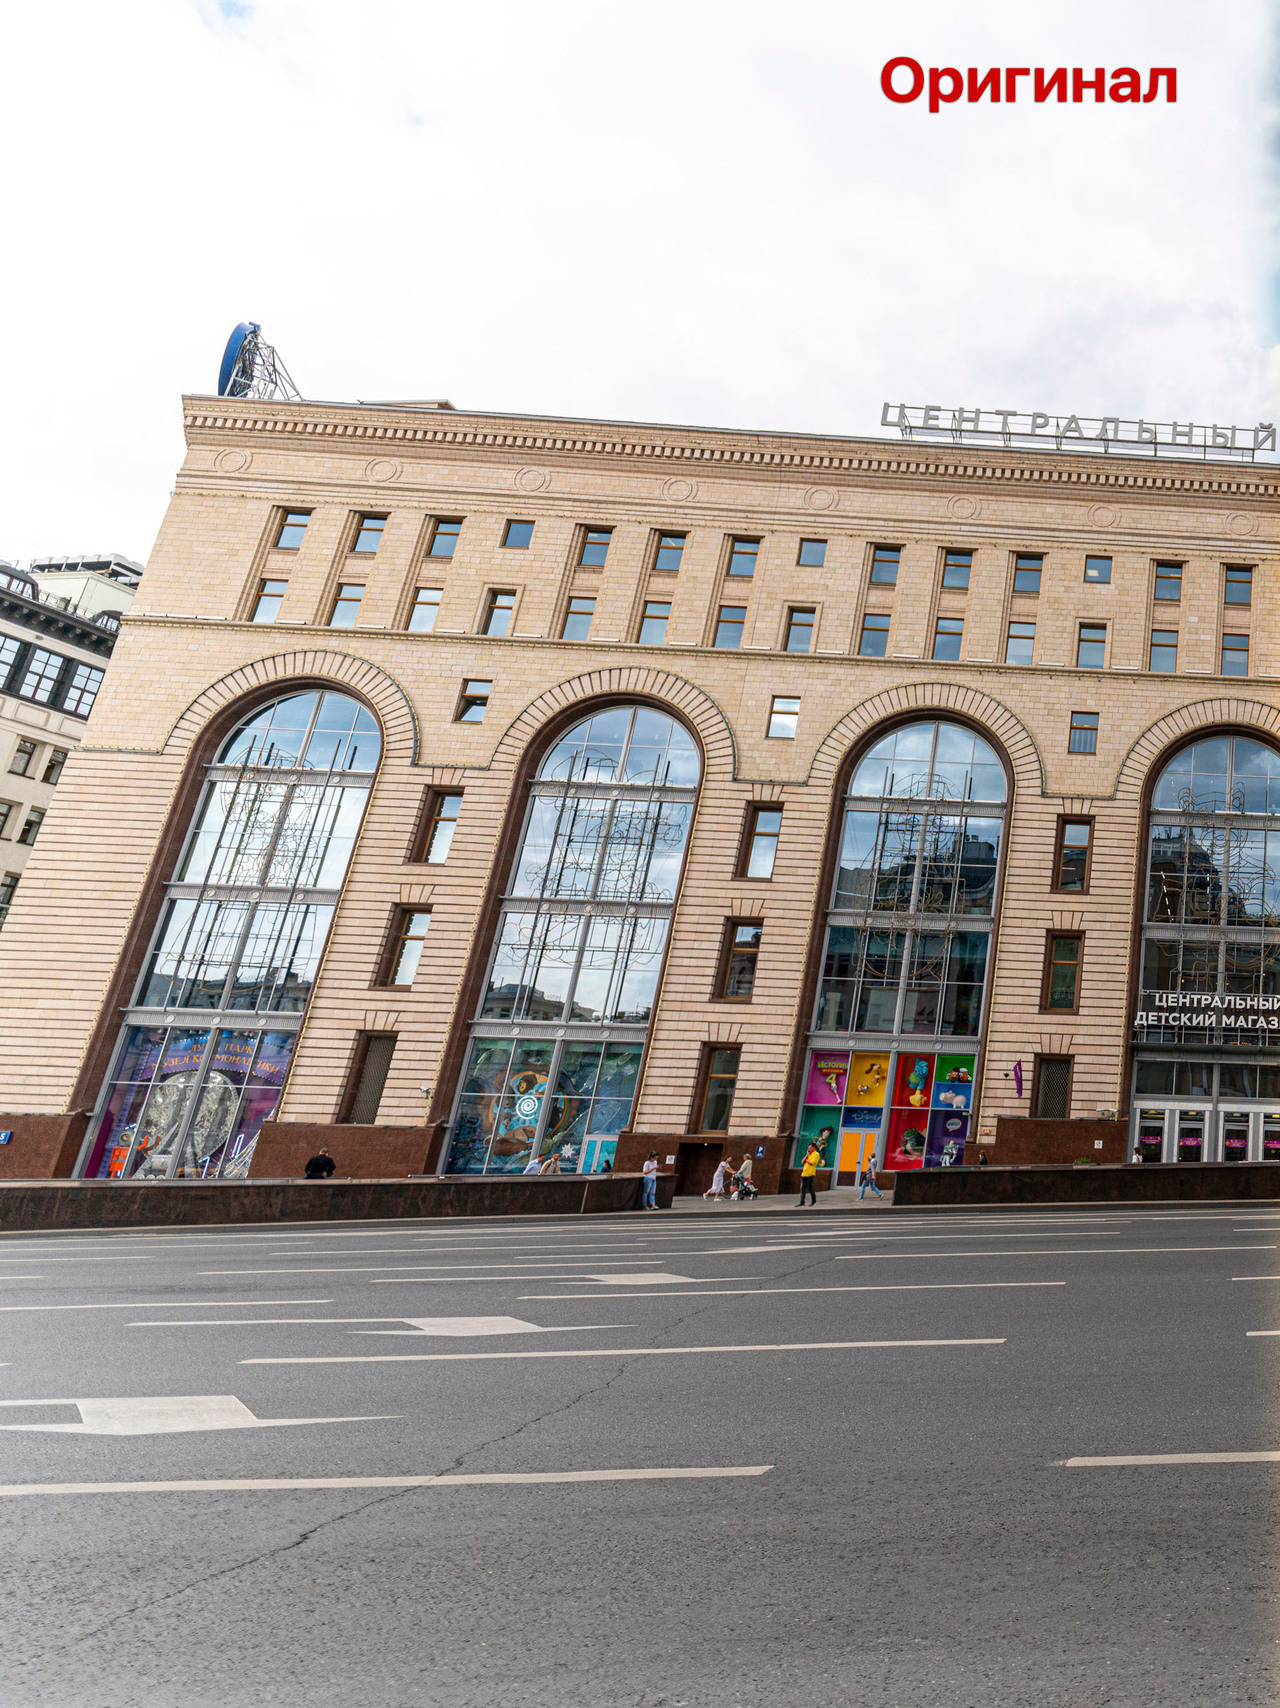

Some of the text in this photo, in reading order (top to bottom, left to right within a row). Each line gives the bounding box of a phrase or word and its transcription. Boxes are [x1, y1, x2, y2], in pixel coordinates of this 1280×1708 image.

[881, 402, 1277, 452] ЦЕНТРАЛЬНЫЙ
[1134, 1011, 1216, 1027] ДЕТСКИЙ
[825, 1073, 838, 1083] 4
